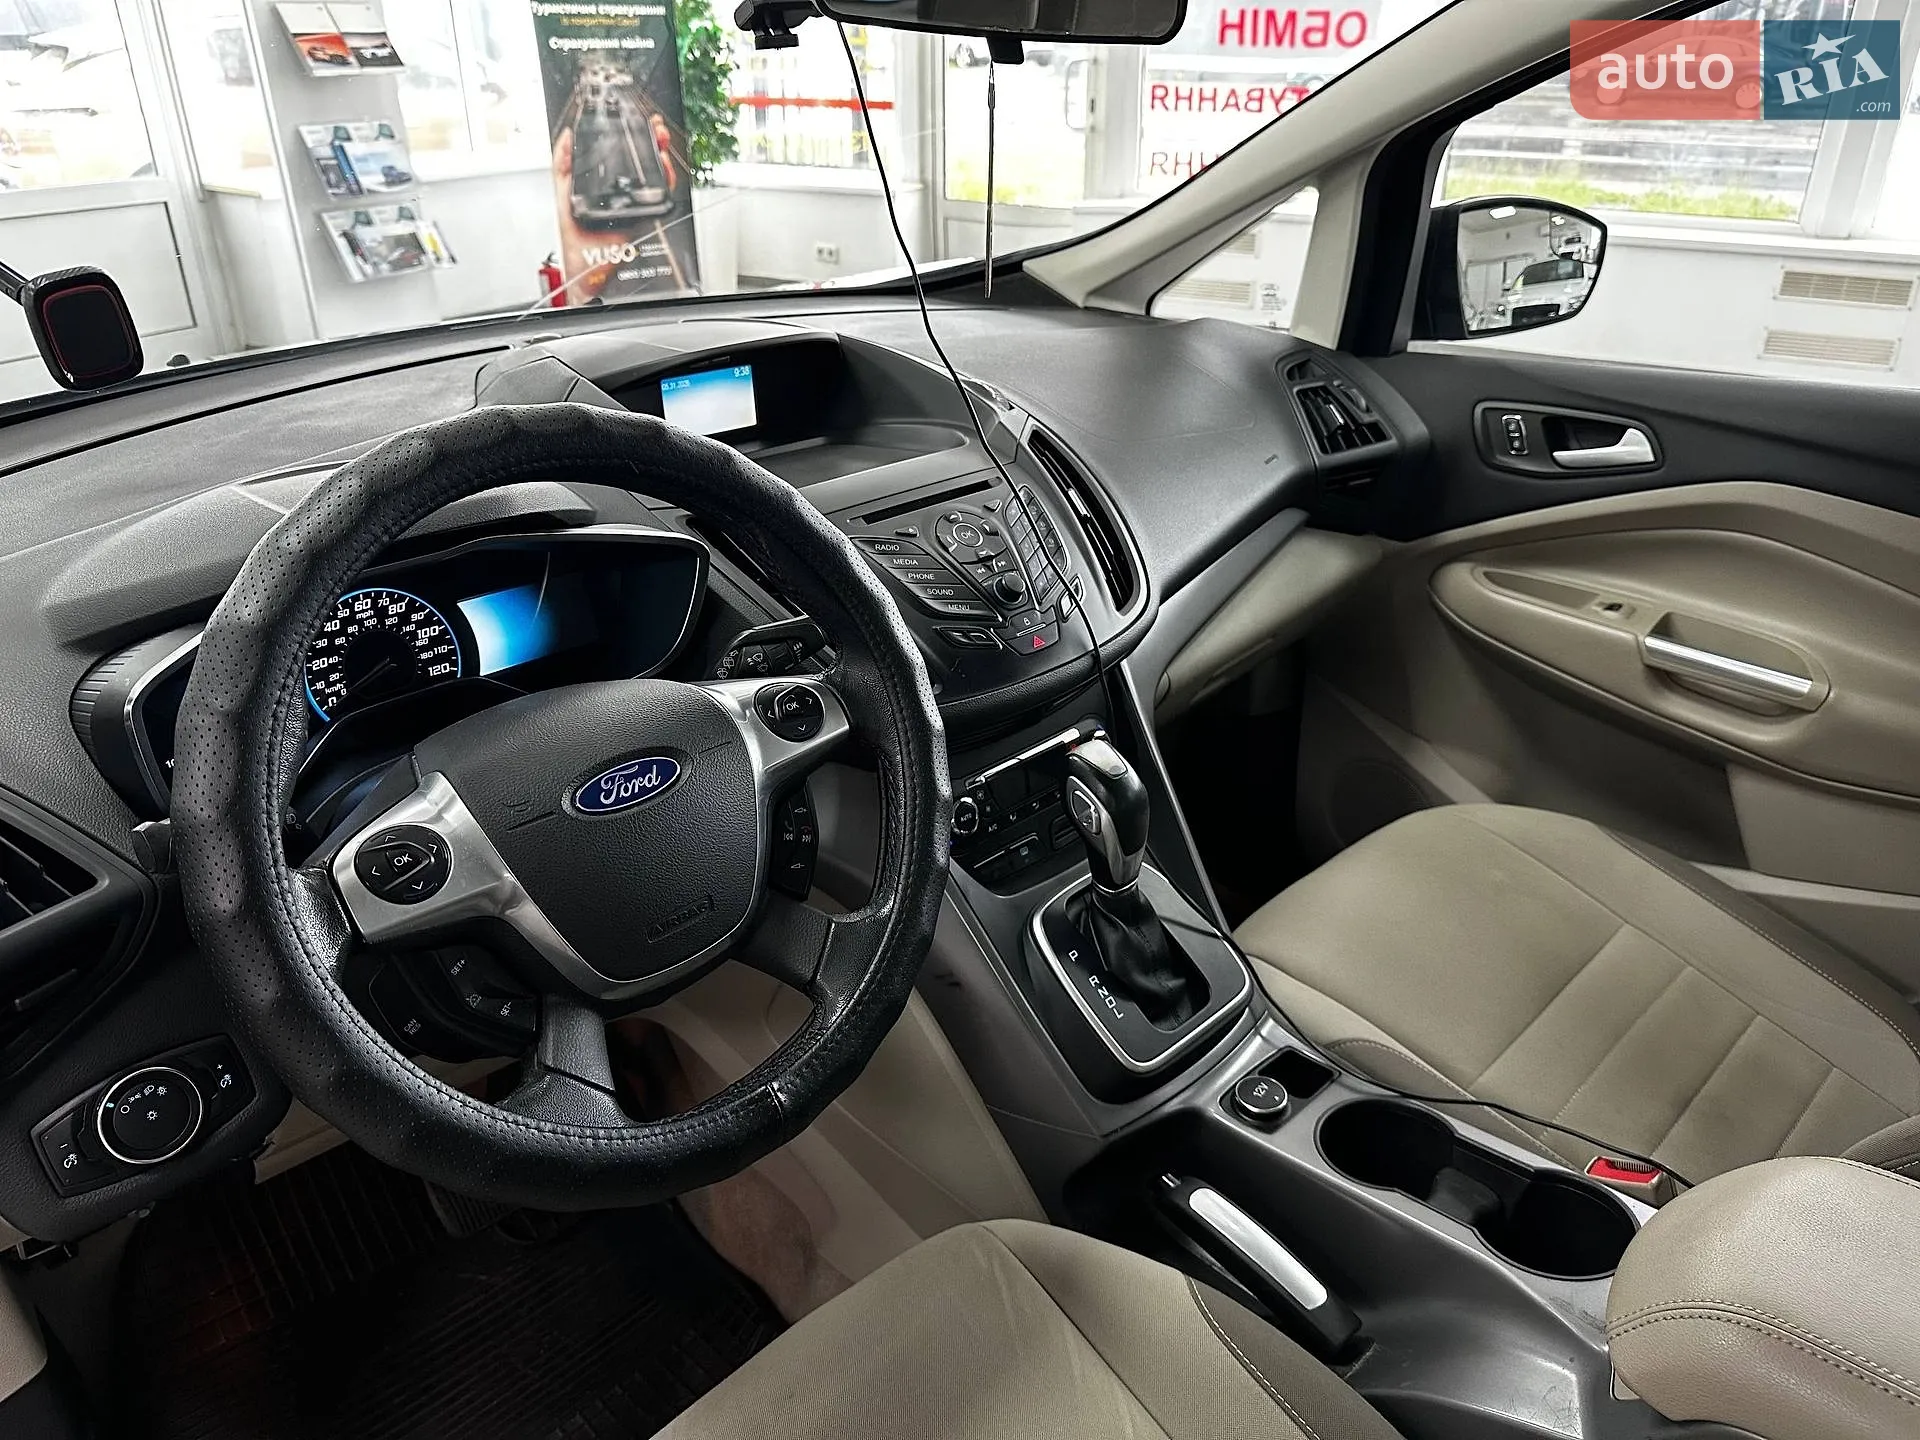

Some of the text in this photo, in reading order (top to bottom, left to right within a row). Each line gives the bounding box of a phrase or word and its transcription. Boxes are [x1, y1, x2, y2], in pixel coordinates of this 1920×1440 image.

[961, 530, 974, 540] OK
[875, 543, 900, 551] RADIO
[927, 588, 954, 596] SOUND
[354, 599, 371, 611] 60
[378, 597, 390, 608] 70
[337, 609, 349, 618] 50
[388, 602, 406, 615] 80
[356, 609, 374, 620] mph
[411, 611, 424, 622] 90
[324, 620, 340, 631] 40
[363, 617, 377, 627] 100
[385, 616, 398, 626] 120
[347, 625, 358, 634] 80
[402, 623, 416, 632] 140
[416, 625, 439, 639] 100
[316, 638, 328, 649] 30
[335, 637, 346, 646] 60
[415, 638, 429, 647] 160
[419, 650, 433, 660] 180
[433, 645, 448, 655] 110
[312, 657, 328, 670] 20
[328, 655, 339, 664] 40
[428, 662, 450, 676] 120
[329, 672, 340, 682] 20
[315, 680, 326, 690] 10
[325, 683, 344, 694] km/h
[340, 688, 347, 696] 0
[786, 701, 800, 712] OK
[600, 765, 661, 805] Ford
[394, 852, 413, 867] OK
[450, 959, 465, 976] SET+
[1069, 950, 1124, 1019] P R N D L
[404, 1018, 417, 1032] CAN
[1253, 1081, 1268, 1098] 12V
